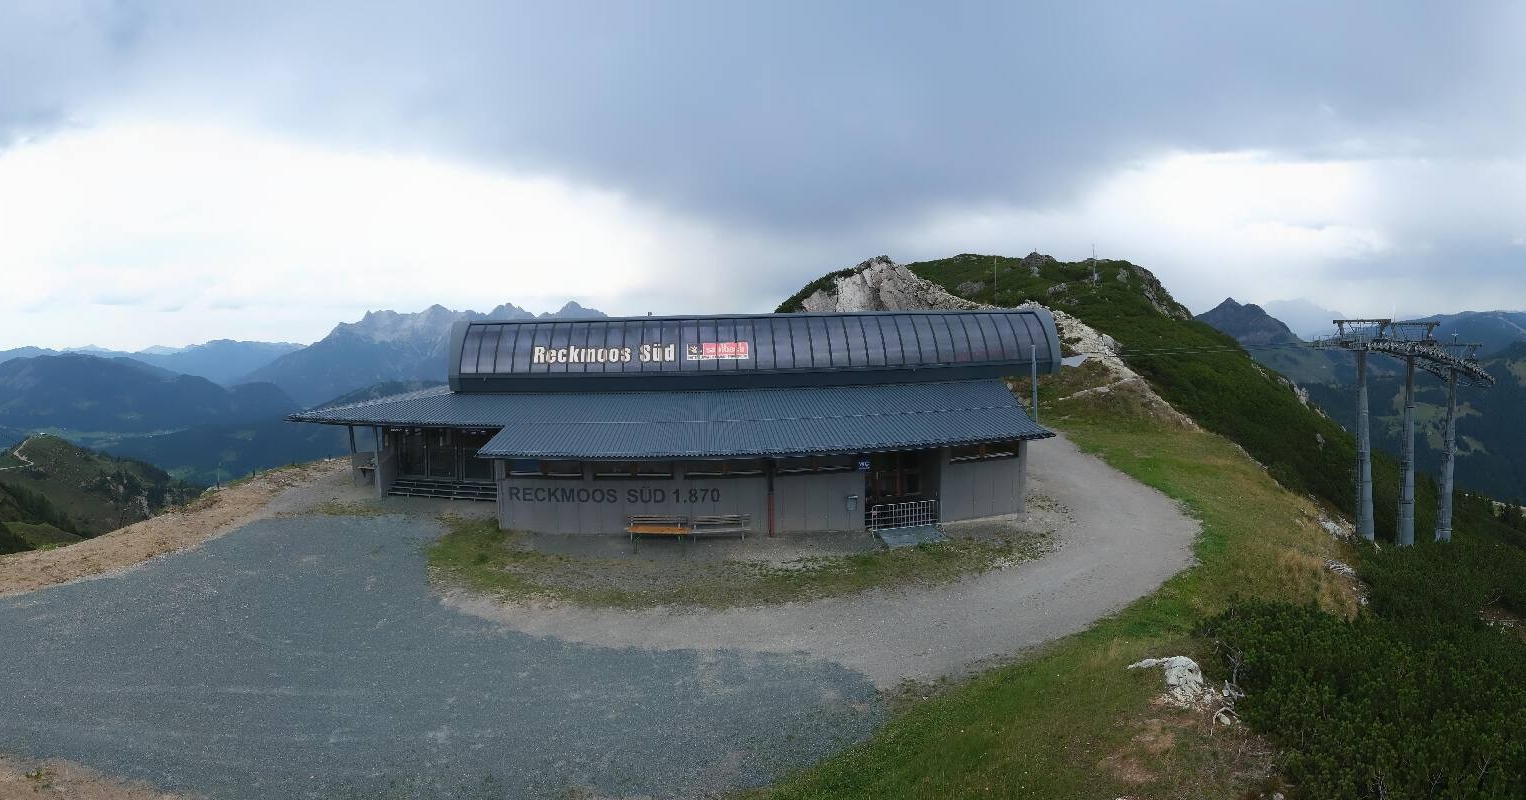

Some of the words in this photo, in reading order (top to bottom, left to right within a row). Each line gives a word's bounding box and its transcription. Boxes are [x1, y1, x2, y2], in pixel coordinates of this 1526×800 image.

[534, 346, 631, 363] Reckmoos
[640, 344, 676, 362] Süd
[509, 486, 618, 503] RECKMOOS
[627, 486, 666, 503] SÜD
[672, 488, 721, 504] 1.870
